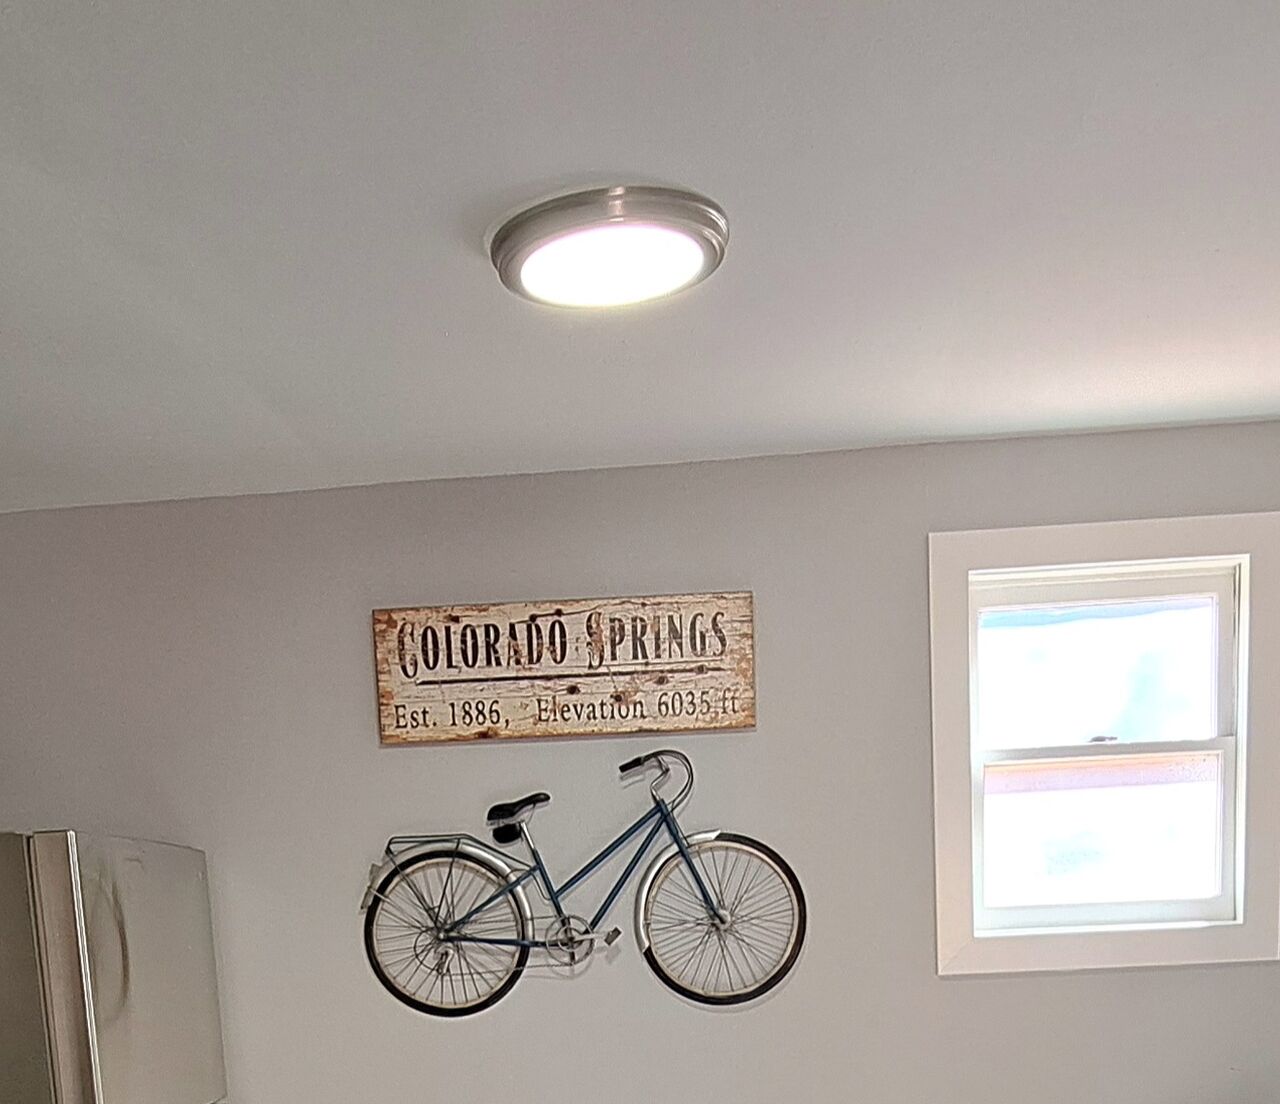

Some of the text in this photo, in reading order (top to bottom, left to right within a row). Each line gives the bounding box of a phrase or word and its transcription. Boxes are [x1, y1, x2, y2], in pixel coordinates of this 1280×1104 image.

[397, 611, 728, 679] COLORADO SPRINGS
[394, 687, 739, 729] Est. 1886, Elevation 6035 ft
